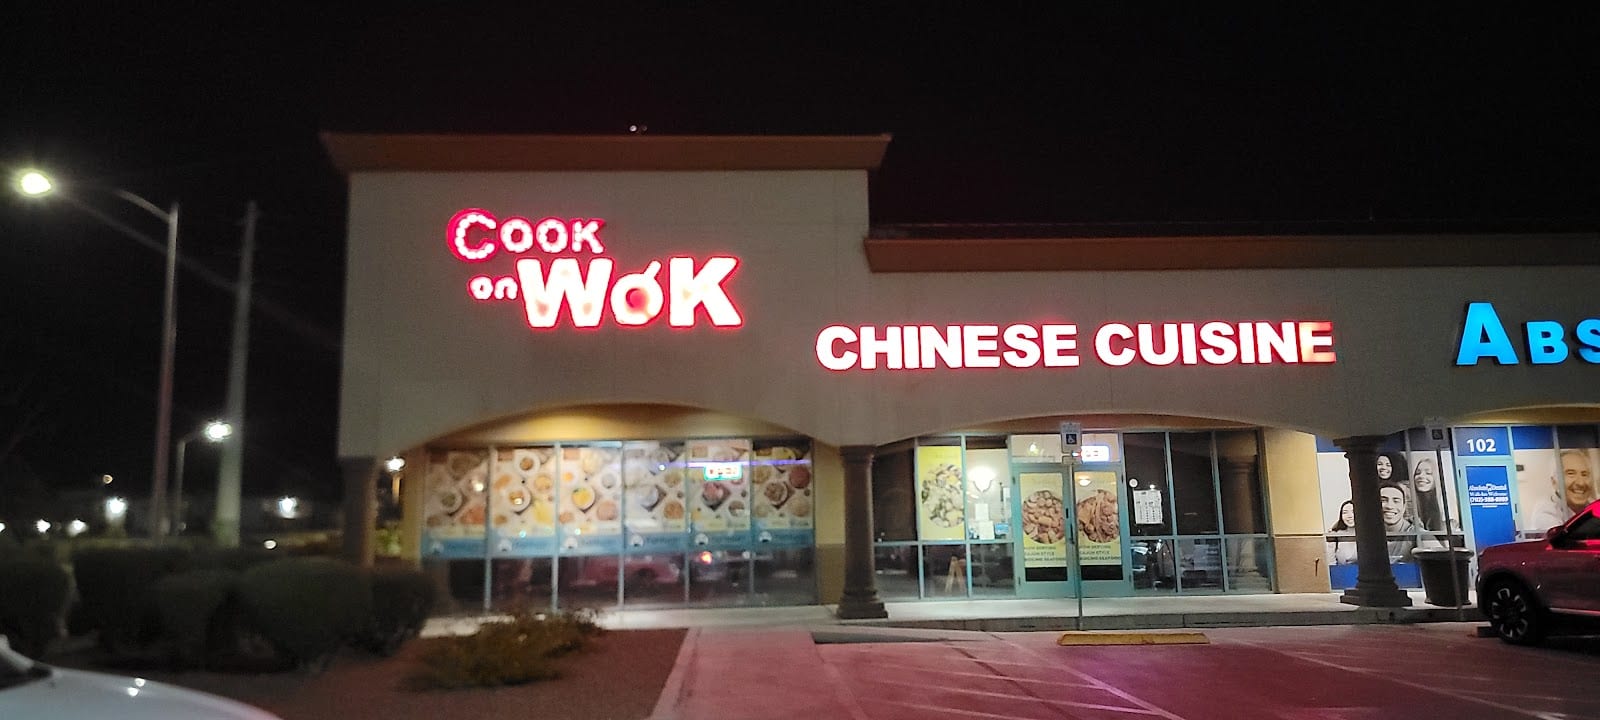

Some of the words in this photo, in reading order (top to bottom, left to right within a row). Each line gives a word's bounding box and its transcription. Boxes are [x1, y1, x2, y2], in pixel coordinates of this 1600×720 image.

[815, 324, 1080, 371] CHINESE
[1094, 319, 1337, 366] CUISINE
[1466, 438, 1497, 453] 102
